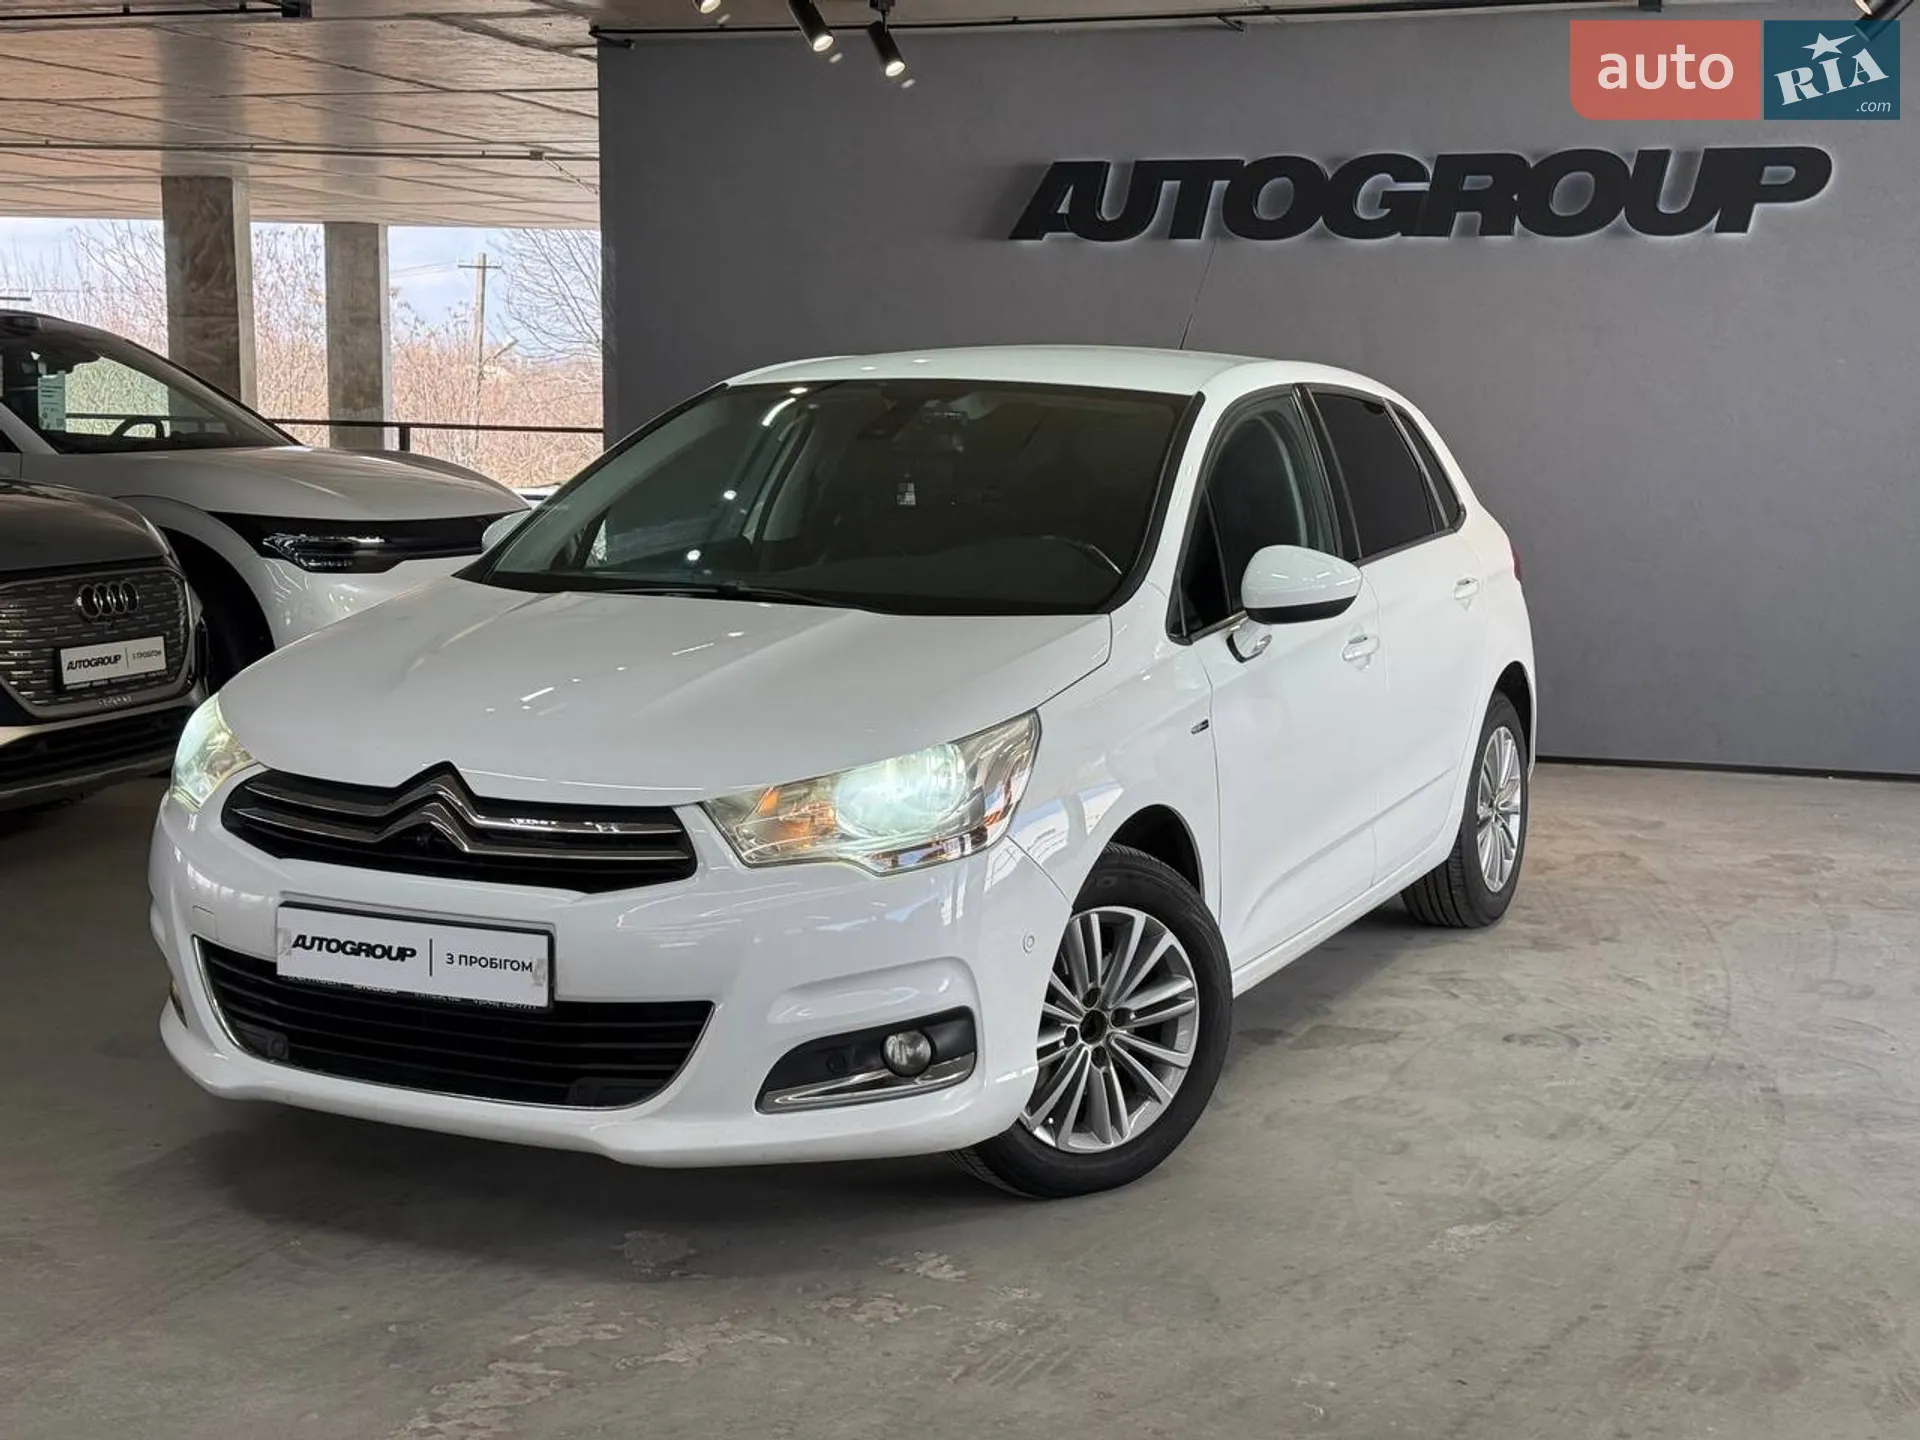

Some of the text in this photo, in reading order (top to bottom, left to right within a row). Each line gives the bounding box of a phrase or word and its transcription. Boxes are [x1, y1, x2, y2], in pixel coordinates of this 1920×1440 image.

[1008, 147, 1833, 241] AUTOGROUP
[66, 653, 122, 671] AUTOGROUP
[291, 934, 417, 962] AUTOGROUP
[458, 954, 533, 973] ПРОБІГОМ
